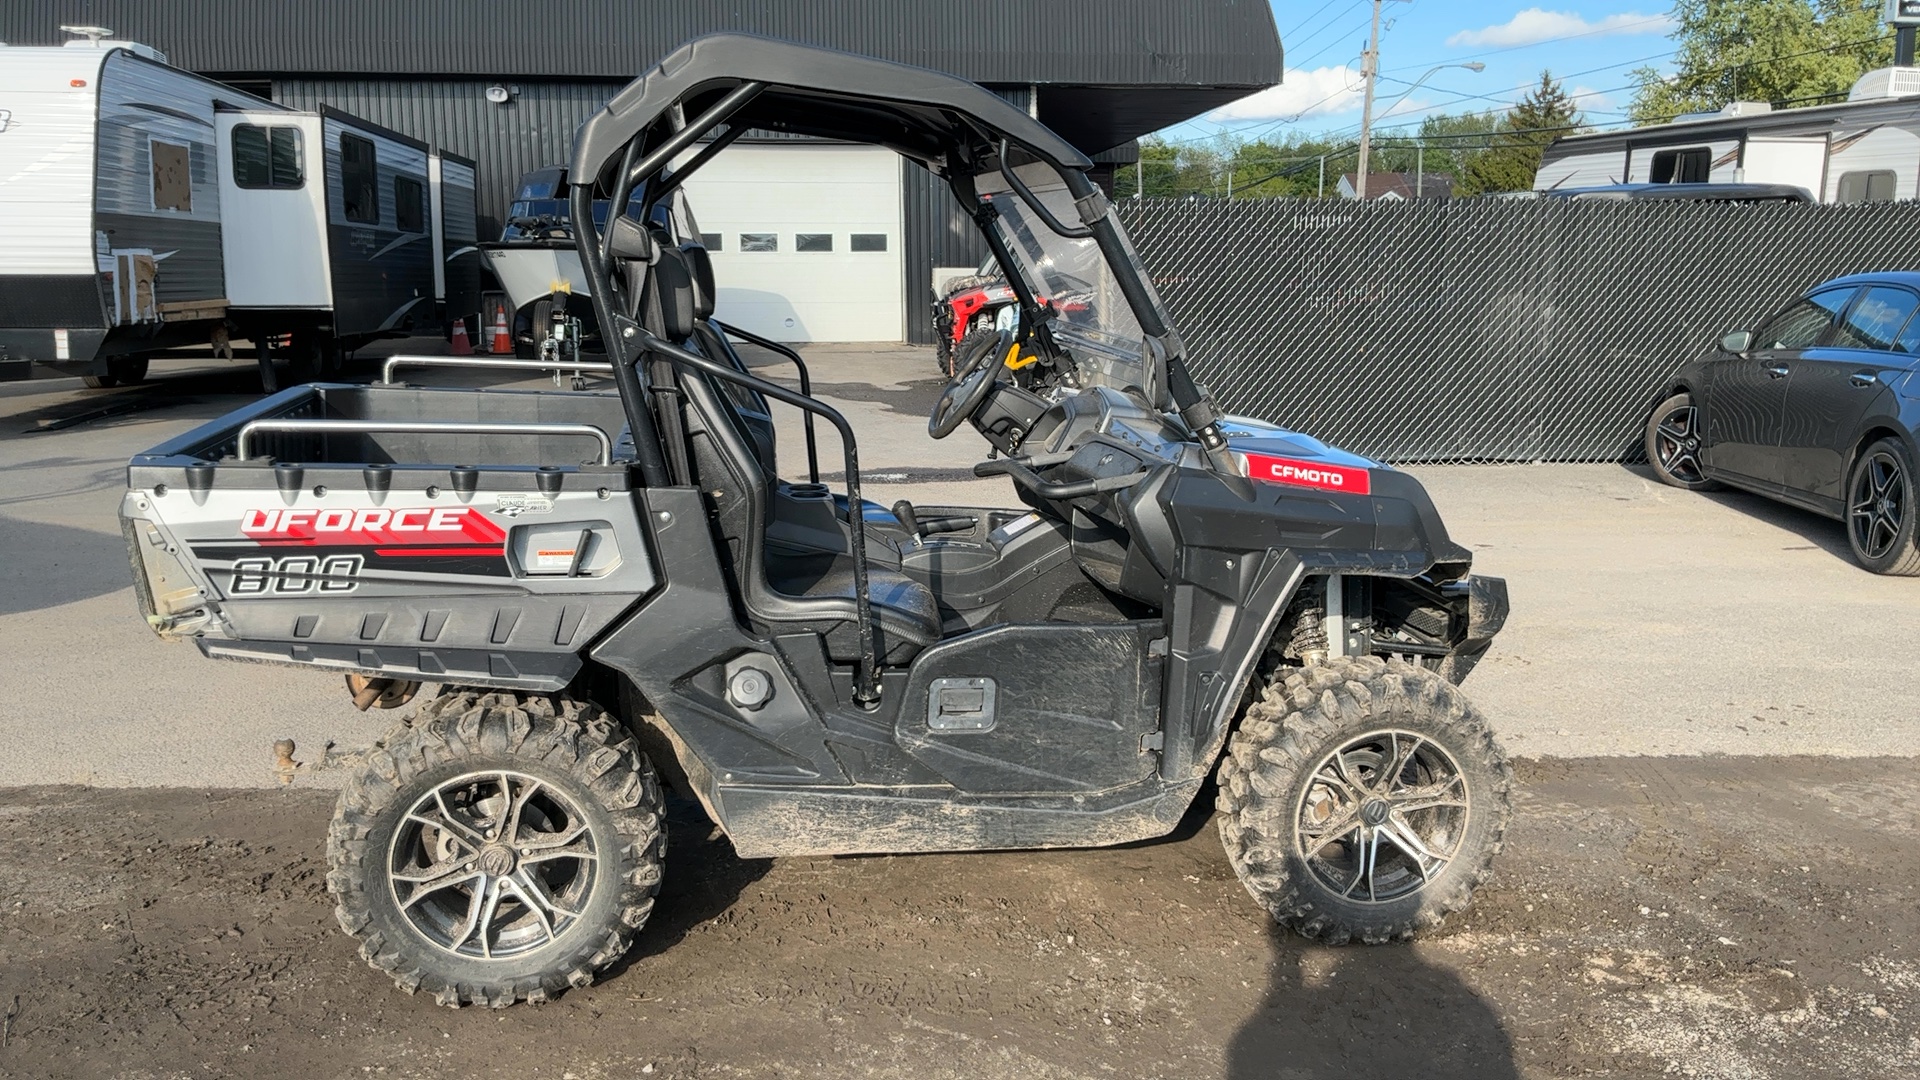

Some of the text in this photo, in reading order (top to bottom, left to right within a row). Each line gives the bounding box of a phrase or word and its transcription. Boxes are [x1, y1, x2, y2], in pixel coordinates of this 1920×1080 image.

[1271, 463, 1343, 486] CFMOTO
[240, 508, 470, 532] UFORCE
[228, 553, 366, 597] 800
